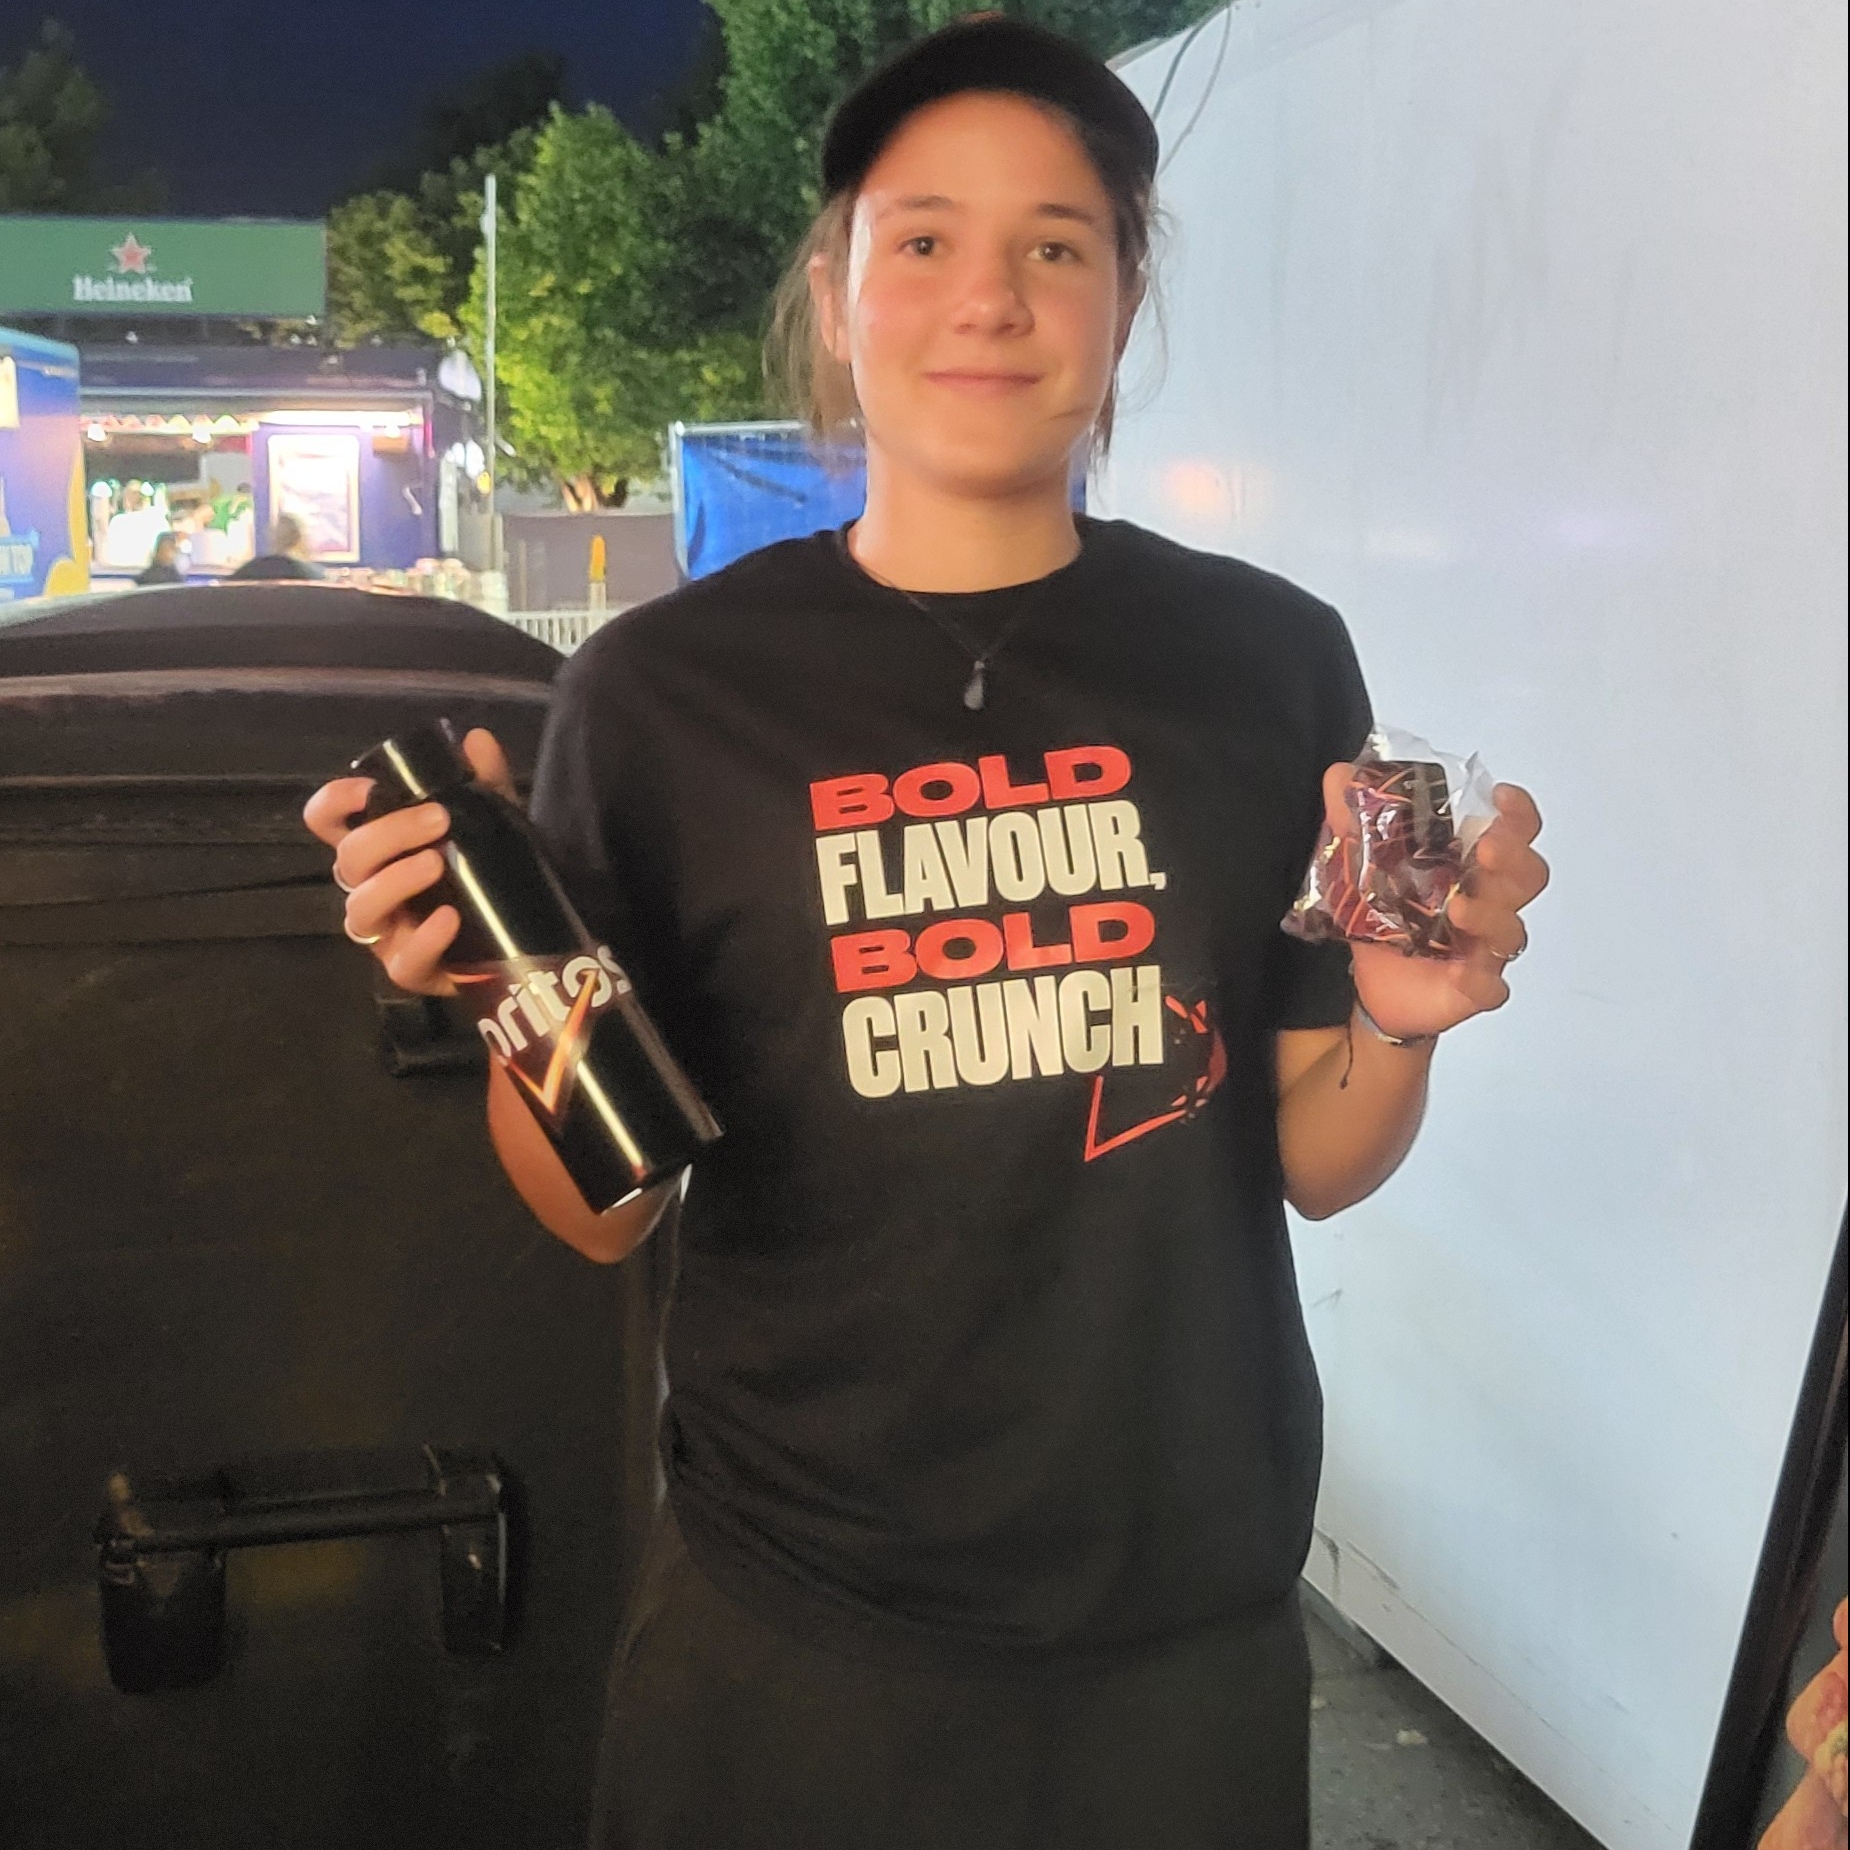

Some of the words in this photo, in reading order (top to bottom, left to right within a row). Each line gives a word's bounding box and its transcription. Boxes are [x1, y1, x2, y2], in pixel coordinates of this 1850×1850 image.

[73, 274, 193, 302] Heineken
[810, 745, 1131, 831] BOLD
[815, 800, 1166, 926] FLAVOUR,
[831, 901, 1155, 993] BOLD
[842, 965, 1164, 1098] CRUNCH
